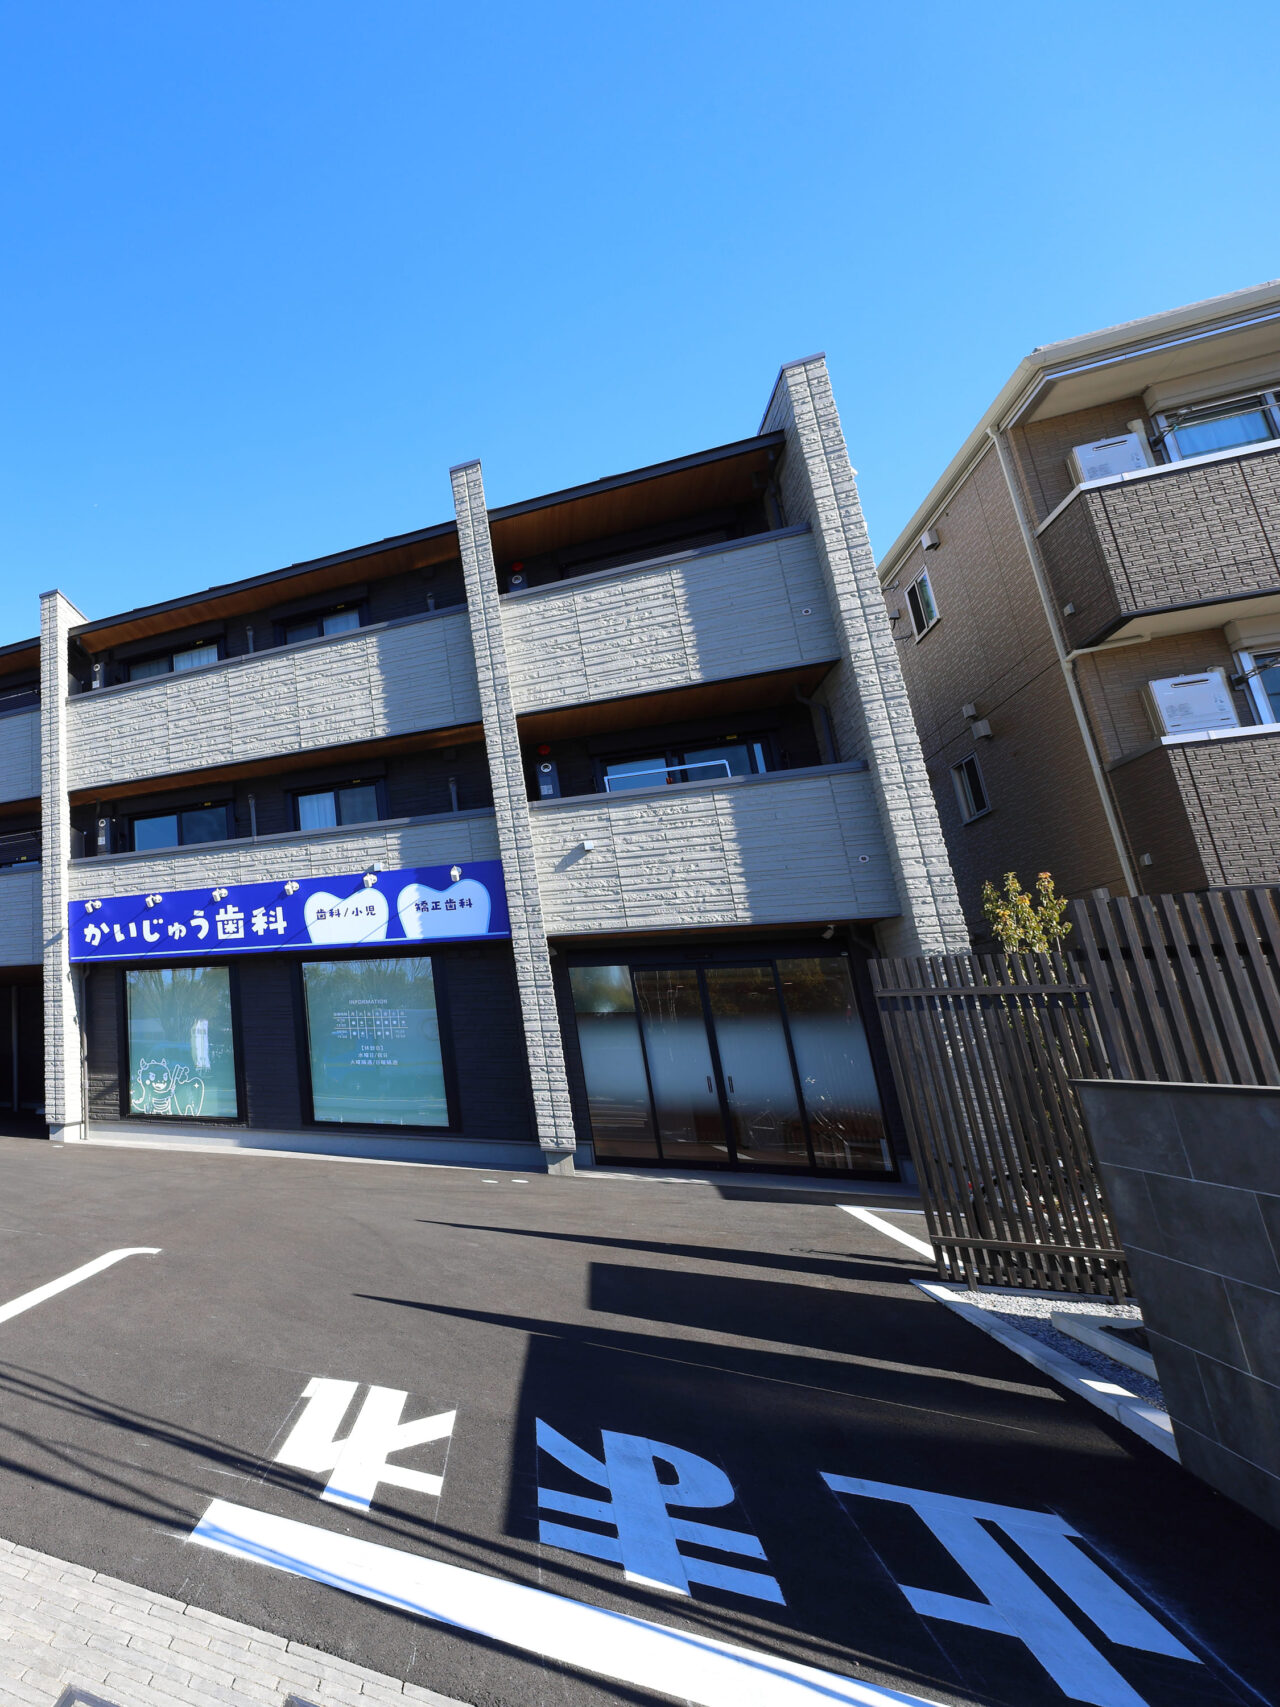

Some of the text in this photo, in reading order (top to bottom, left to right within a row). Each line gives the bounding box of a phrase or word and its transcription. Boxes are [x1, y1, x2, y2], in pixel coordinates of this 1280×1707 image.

[315, 905, 377, 920] 歯科/小児
[414, 898, 473, 914] 矯正歯科
[83, 905, 287, 946] かいじゅう歯科
